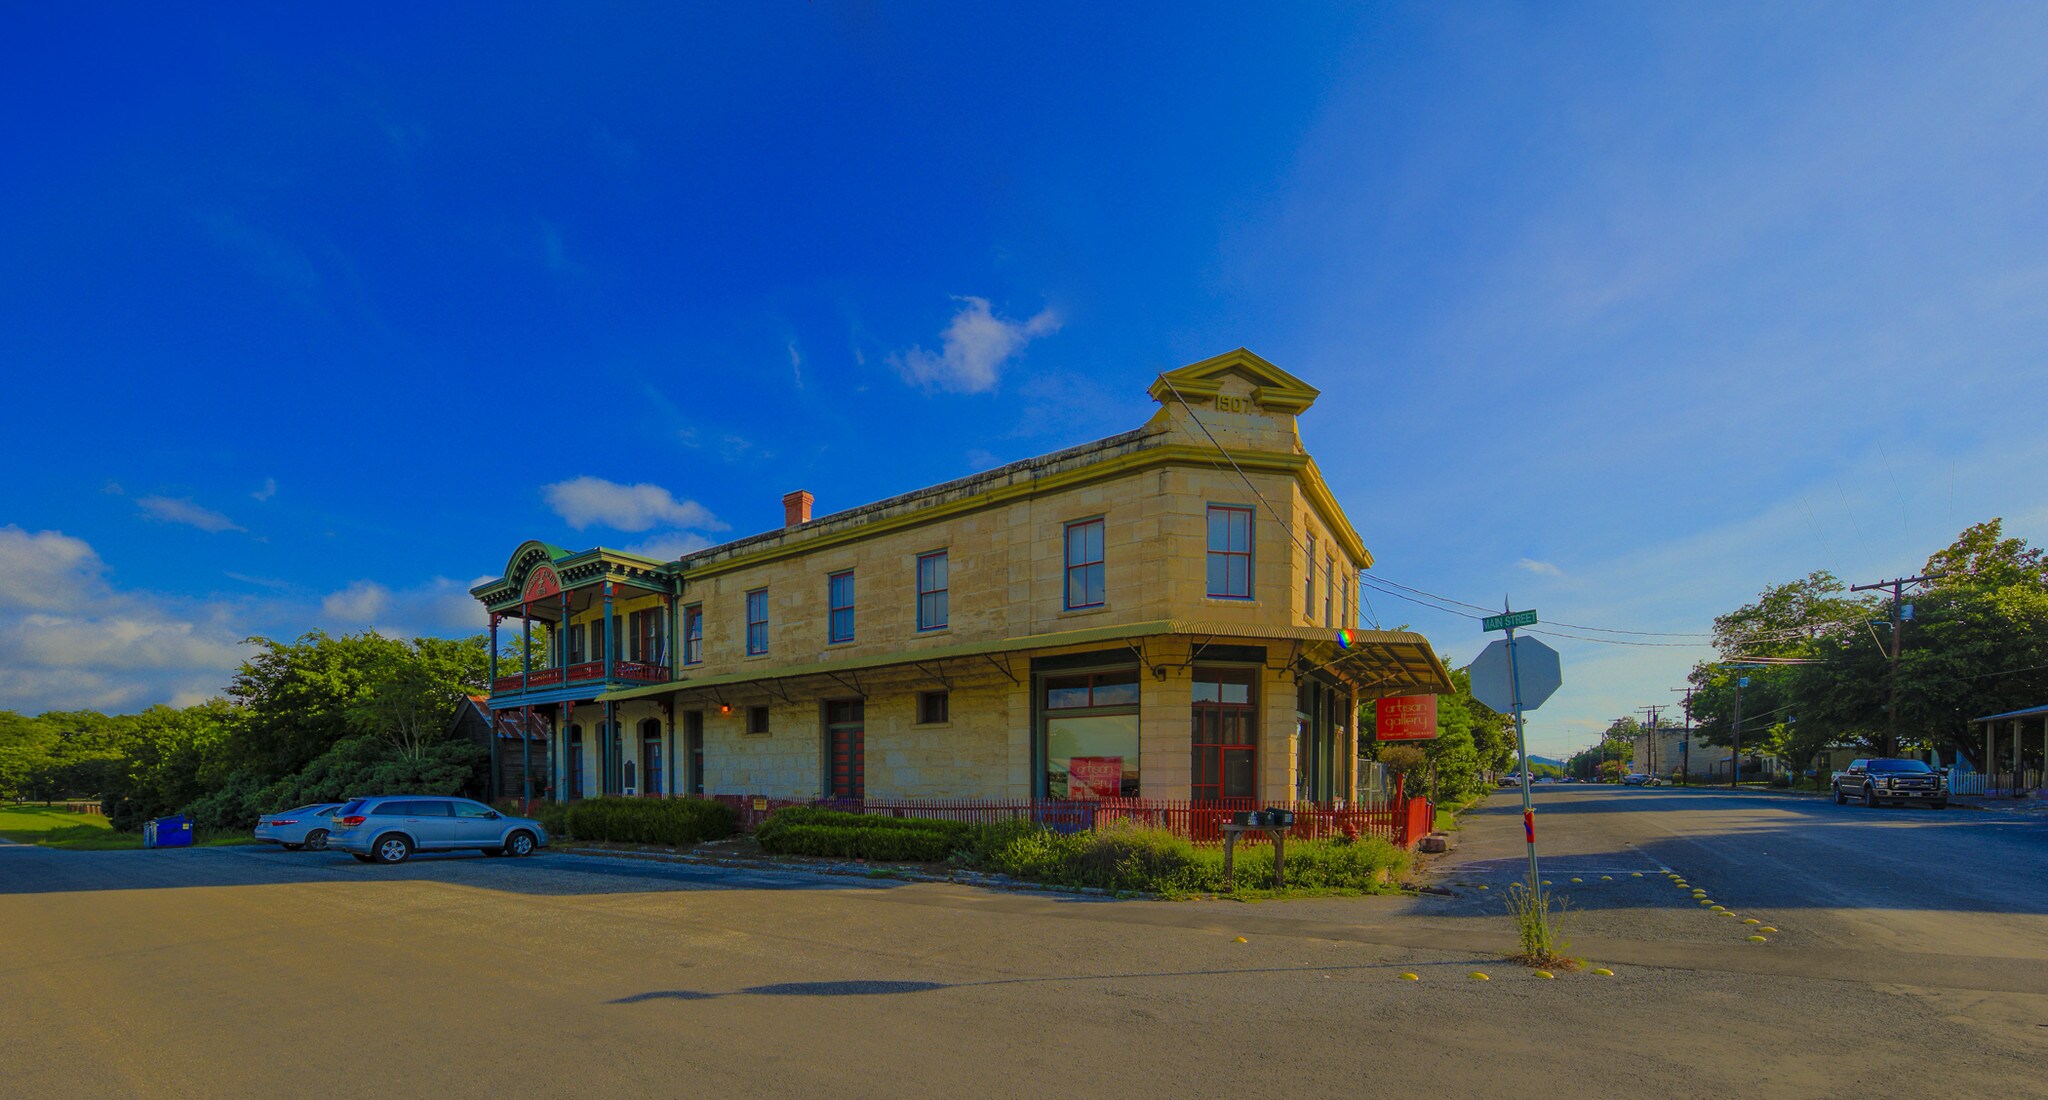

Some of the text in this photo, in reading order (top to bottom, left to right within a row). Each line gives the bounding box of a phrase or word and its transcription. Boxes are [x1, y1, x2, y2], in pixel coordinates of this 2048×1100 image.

[1216, 395, 1252, 414] 1907
[1483, 612, 1536, 629] MAIN STREET
[1385, 699, 1427, 713] artisan
[1385, 712, 1428, 731] gallery
[1076, 760, 1114, 774] artisan
[1075, 773, 1113, 794] gallery
